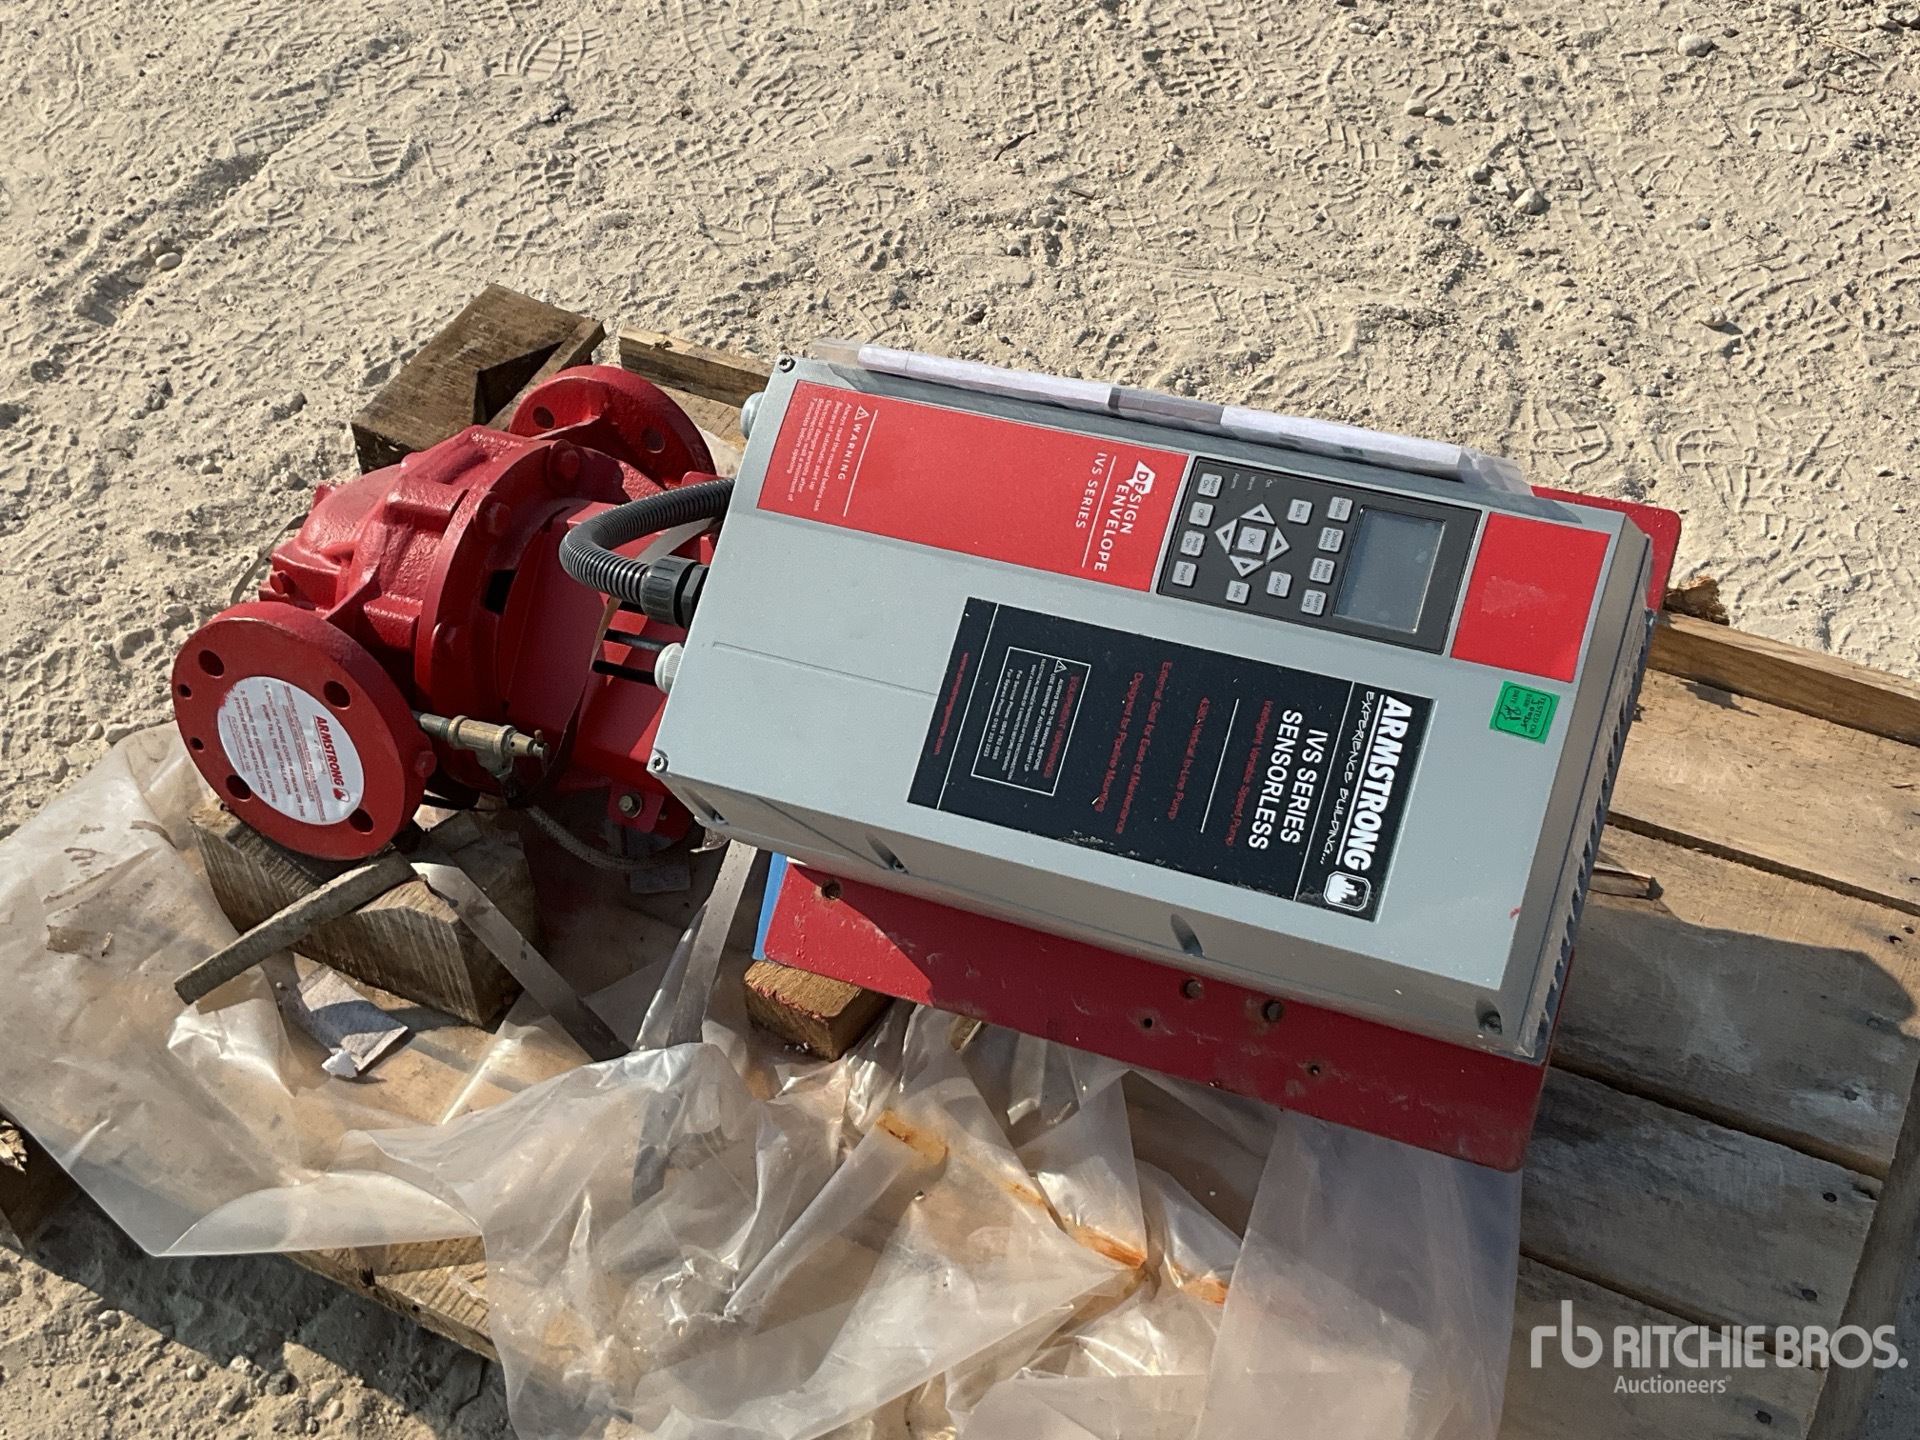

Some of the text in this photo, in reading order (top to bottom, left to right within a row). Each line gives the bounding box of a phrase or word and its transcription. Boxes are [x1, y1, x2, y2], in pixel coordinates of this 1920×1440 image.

[838, 403, 851, 427] Always
[794, 427, 806, 447] before
[808, 428, 821, 450] danger
[816, 432, 832, 464] automatic
[834, 427, 844, 442] read
[784, 448, 798, 473] opening
[837, 422, 862, 480] WARNING
[796, 477, 806, 492] after
[811, 465, 821, 480] start
[817, 478, 828, 498] before
[1074, 451, 1107, 528] IVS SERIES
[1119, 470, 1149, 534] DESIGN
[1333, 499, 1344, 517] Status
[1094, 484, 1129, 572] ENVELOPE
[1247, 533, 1256, 544] OK
[1179, 564, 1188, 581] Reset
[1009, 680, 1019, 700] Service
[1042, 675, 1079, 779] EQUIPMENT WARNINGS
[1094, 671, 1143, 813] Designed for Pipeline Mounting
[1186, 723, 1203, 757] Vertical
[1340, 690, 1374, 783] EXPERIENCE
[316, 715, 344, 786] ARMSTRONG
[1115, 661, 1171, 833] External Seal for Ease of Maintenance
[1176, 758, 1192, 790] In-Line
[1223, 699, 1272, 846] Intelligent Variable Speed Pump
[1246, 708, 1302, 850] SENSORLESS
[1278, 728, 1328, 844] IVS SERIES
[1341, 695, 1413, 872] ARMSTRONG
[1166, 791, 1183, 820] Pump
